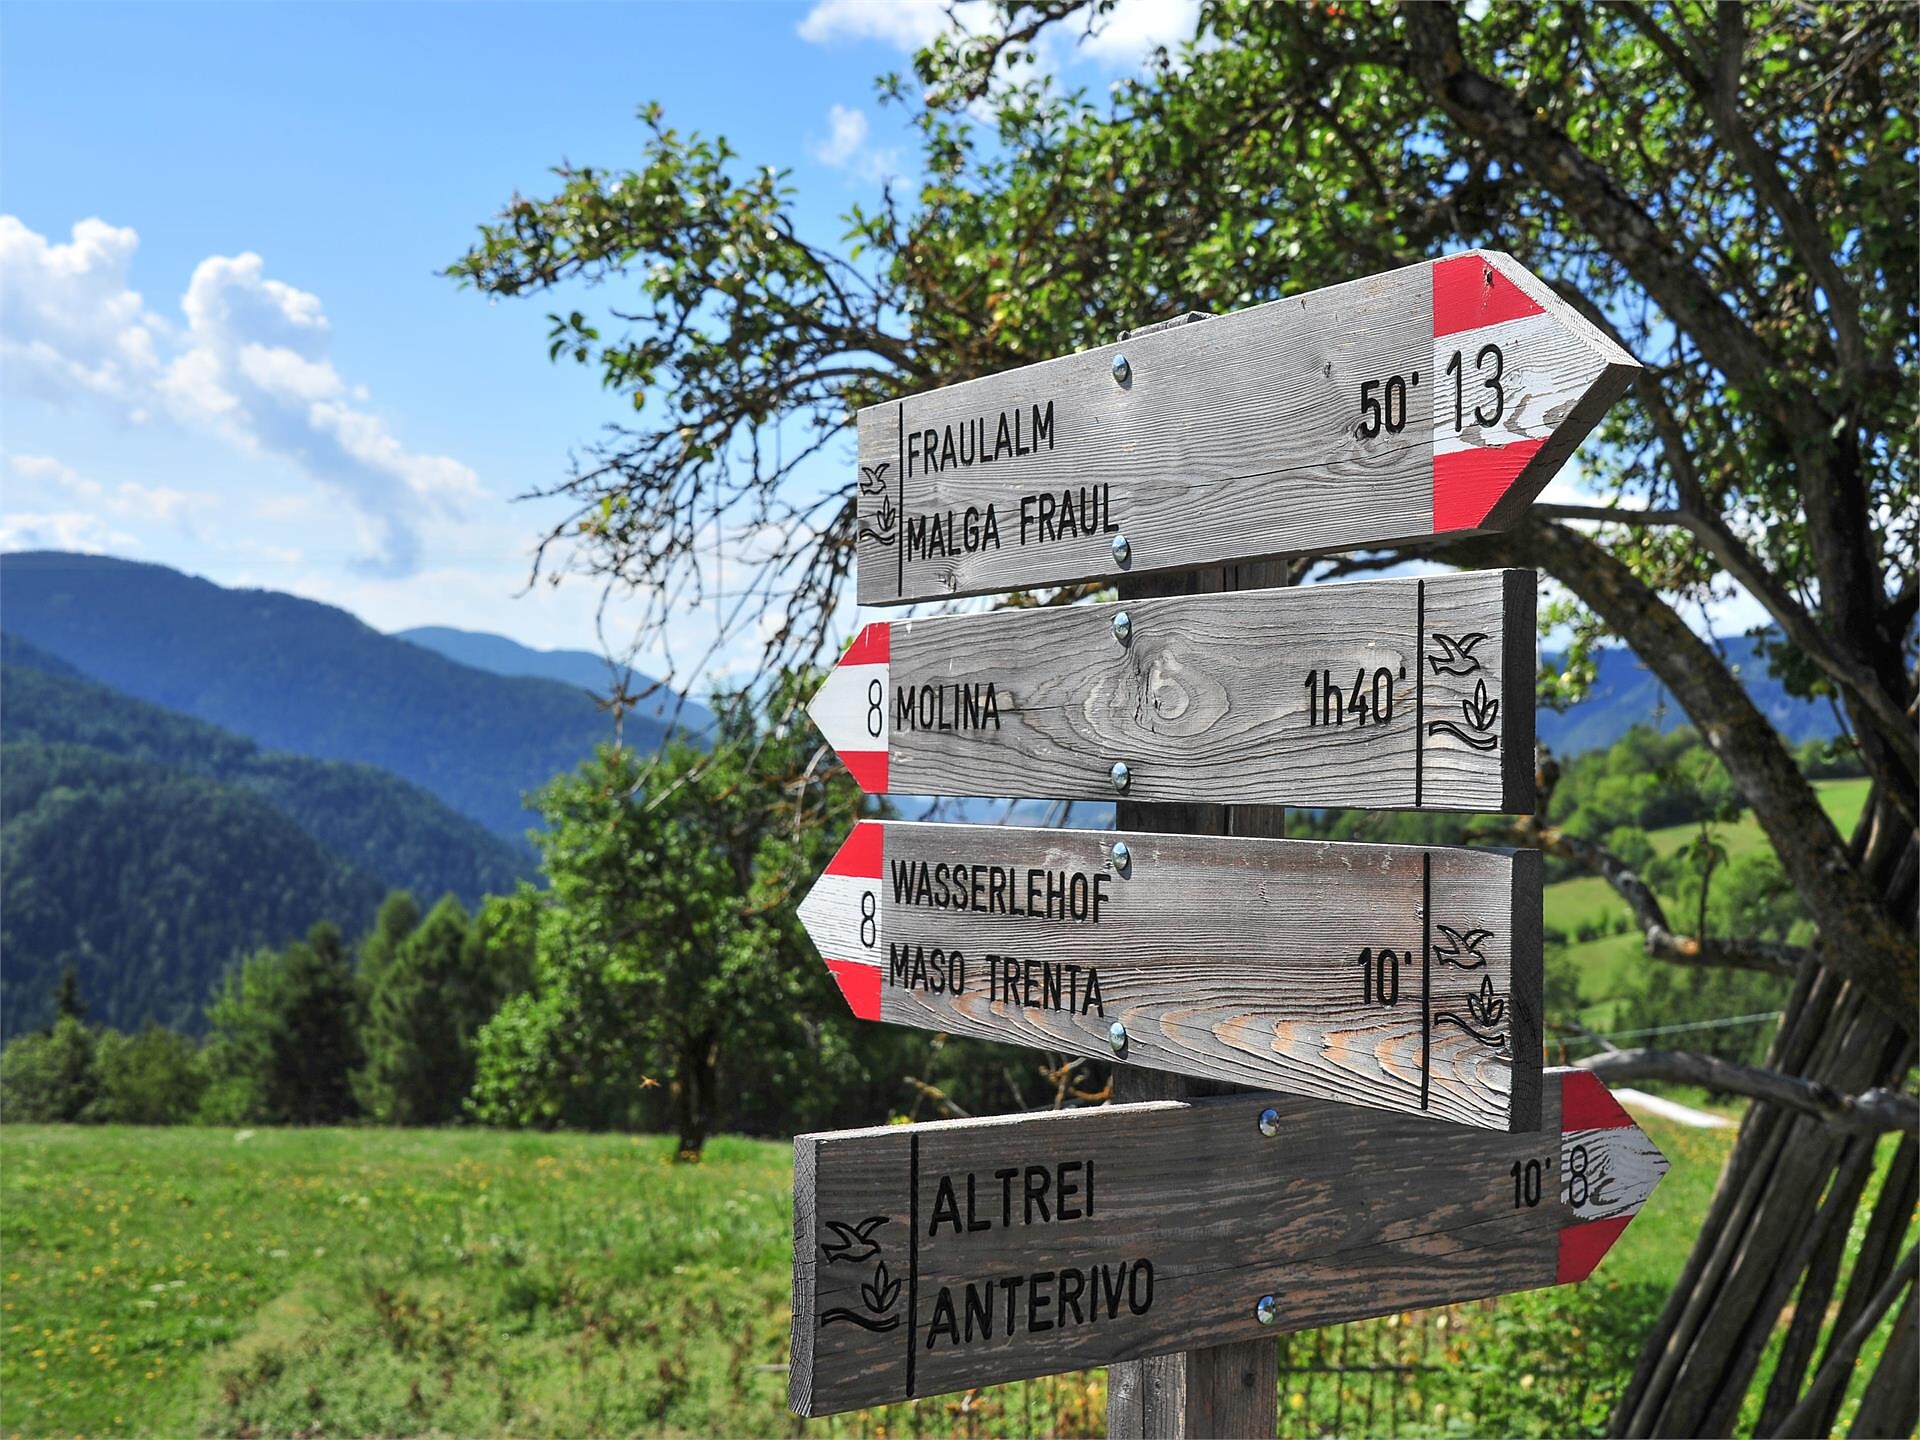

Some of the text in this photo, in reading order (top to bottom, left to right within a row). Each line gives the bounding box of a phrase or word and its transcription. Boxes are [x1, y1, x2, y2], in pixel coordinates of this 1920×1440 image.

[1446, 343, 1504, 433] 13
[908, 400, 1054, 478] FRAULALM
[907, 482, 1119, 562] MALGA FRAUL
[867, 678, 884, 738] 8
[897, 682, 1000, 731] MOLINA
[860, 890, 876, 948] 8
[891, 859, 1111, 924] WASSERLEHOF
[890, 942, 1104, 1018] MASO TRENTA
[928, 1159, 1094, 1237] ALTREI
[1569, 1145, 1588, 1208] 8
[926, 1258, 1154, 1349] ANTERIVO
